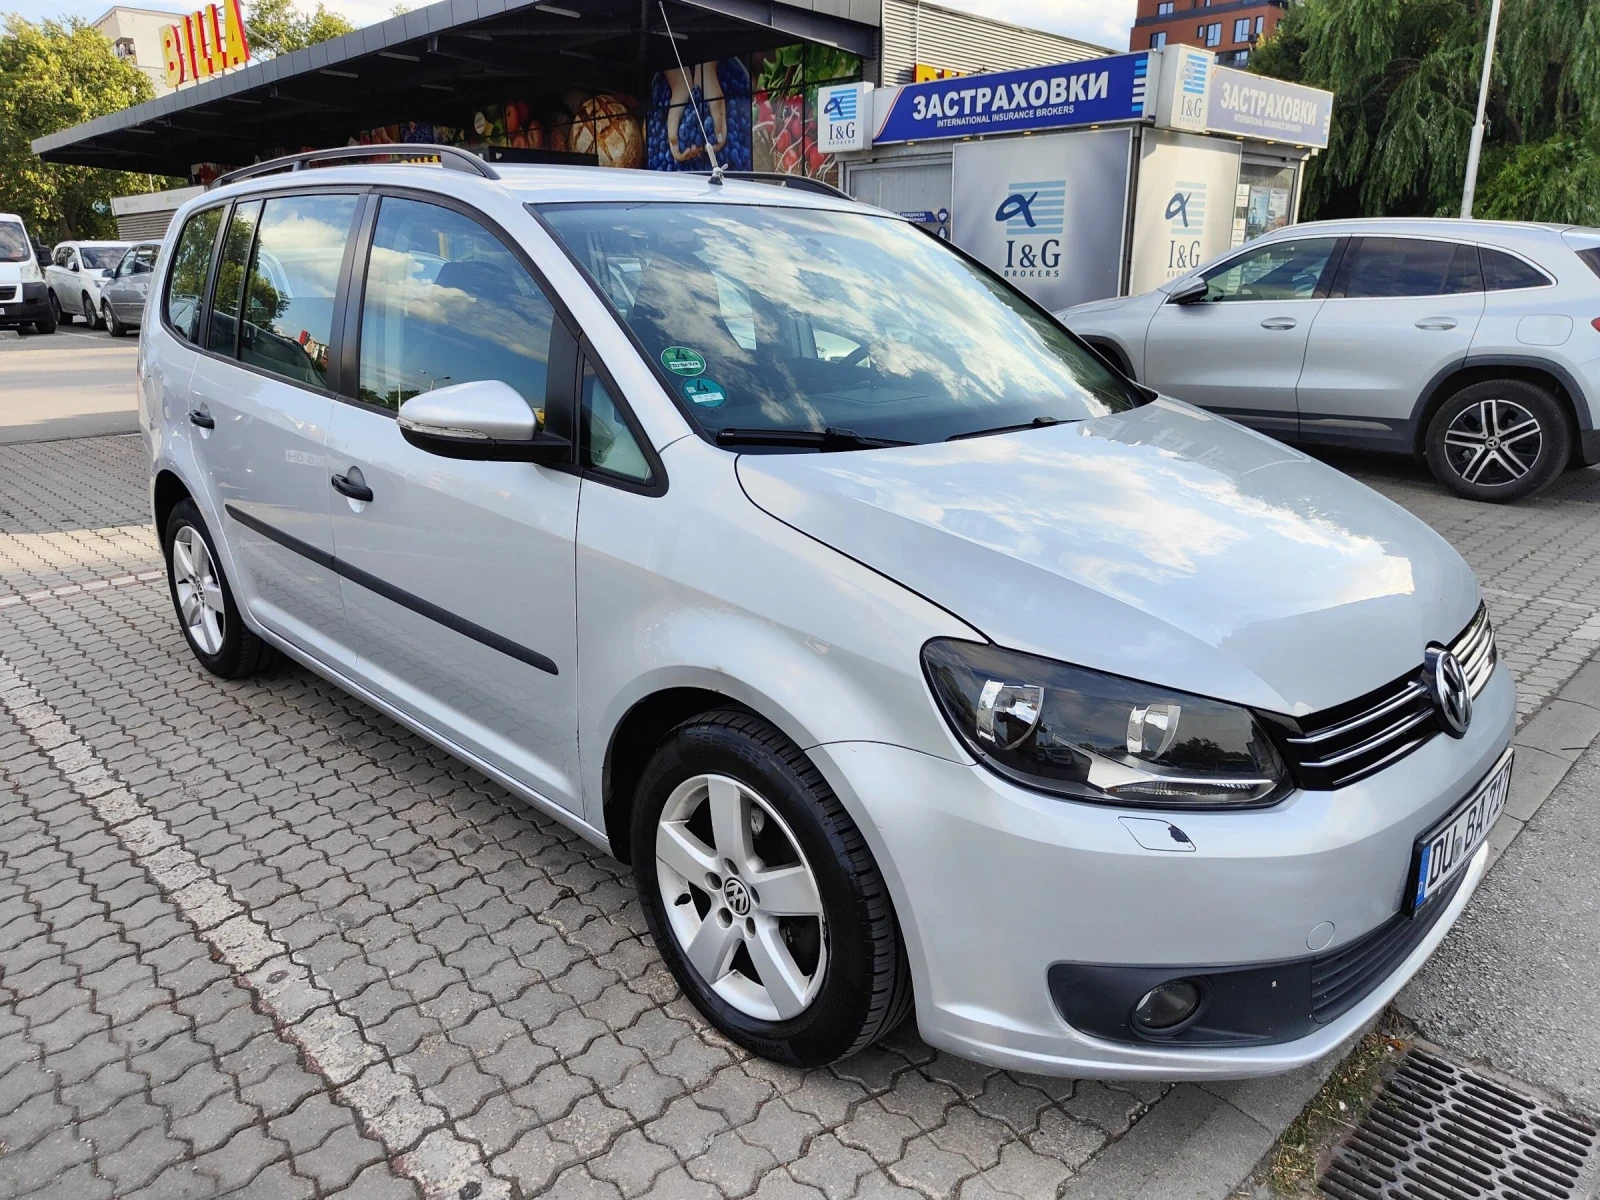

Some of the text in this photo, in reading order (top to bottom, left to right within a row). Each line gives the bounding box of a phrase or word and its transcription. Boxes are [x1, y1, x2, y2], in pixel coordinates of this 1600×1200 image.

[159, 0, 250, 88] BILLA
[913, 71, 1109, 121] ЗАСТРАХОВКИ
[937, 105, 1075, 128] INTERNATIONAL INSURANCE BROKERS
[1222, 83, 1317, 126] ЗАСТРАХОВКИ
[1004, 269, 1059, 278] BROKERS
[1427, 824, 1457, 889] DU
[1464, 795, 1486, 853] BA
